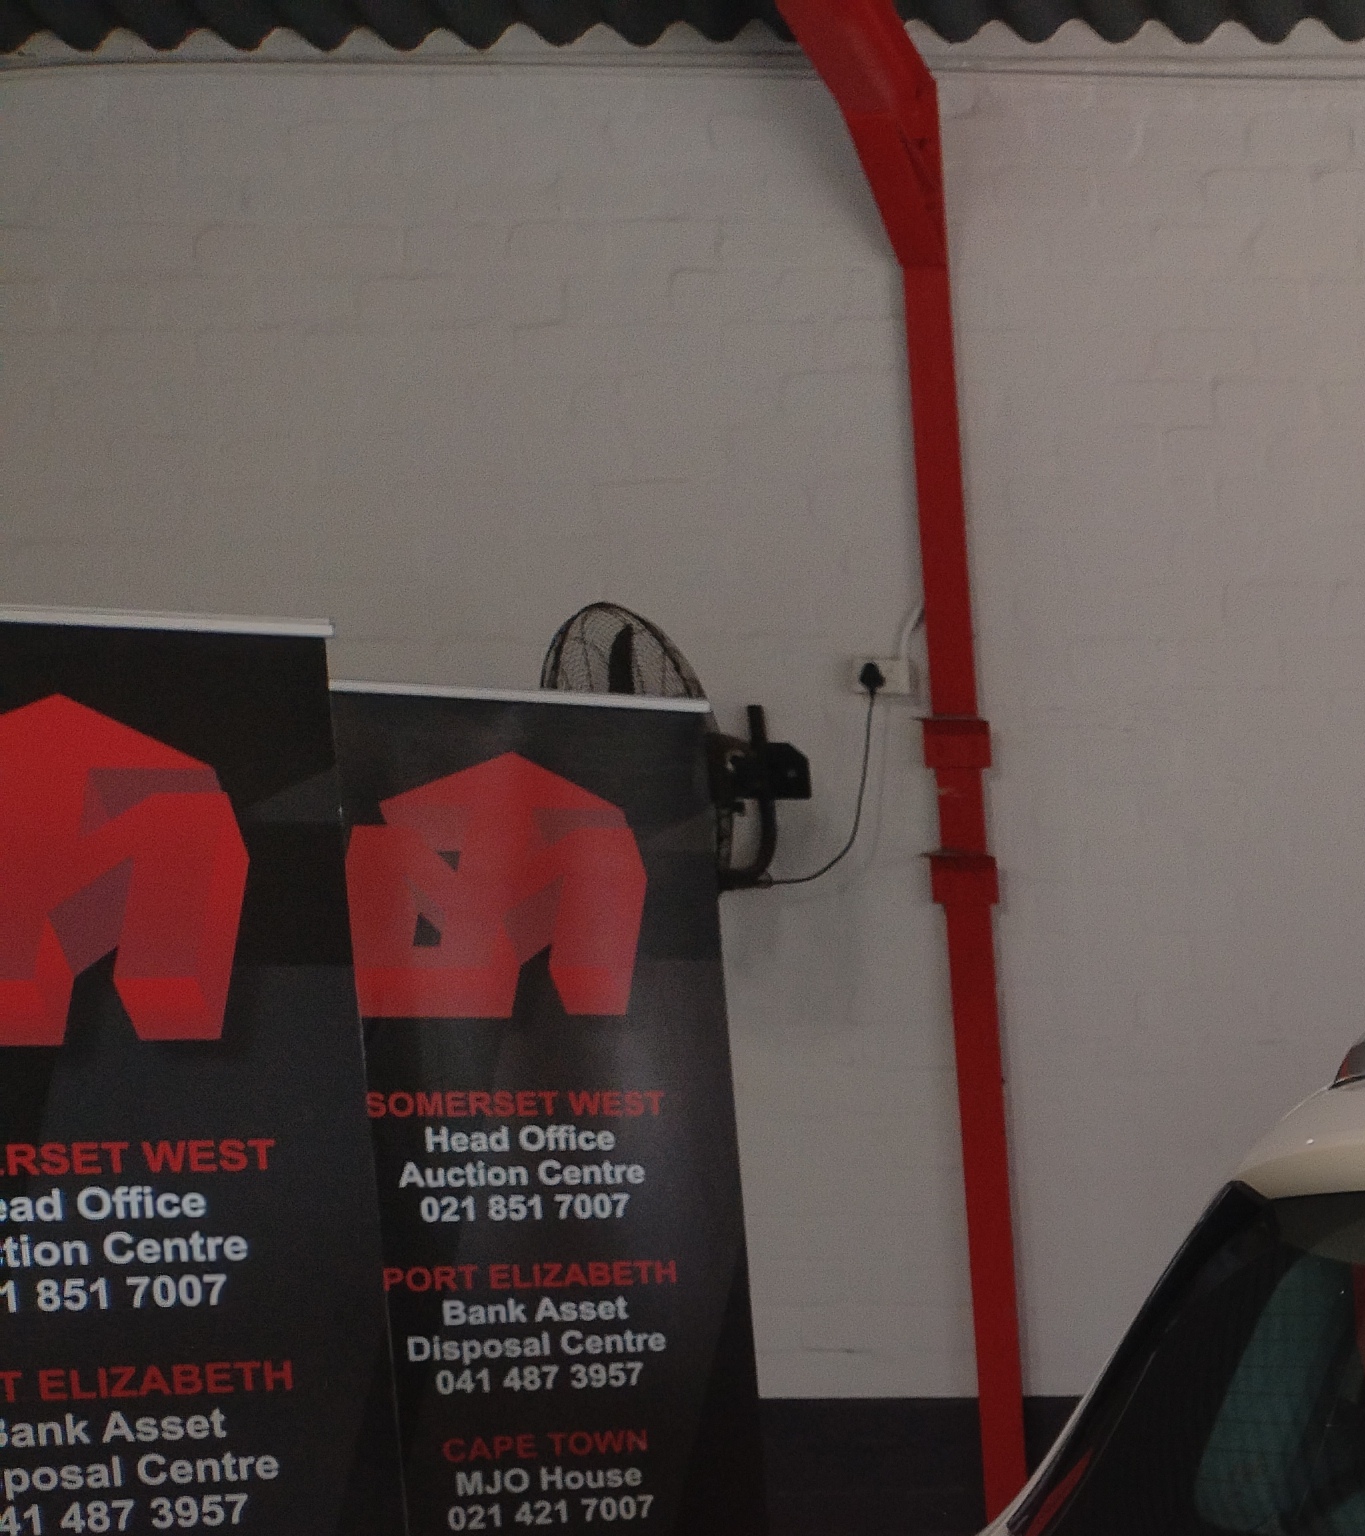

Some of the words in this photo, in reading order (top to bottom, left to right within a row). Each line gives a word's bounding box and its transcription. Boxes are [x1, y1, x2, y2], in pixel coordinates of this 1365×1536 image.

[366, 1090, 559, 1119] SOMERSET
[570, 1090, 667, 1117] WEST
[424, 1125, 510, 1154] Head
[519, 1124, 616, 1152] Office
[0, 1141, 129, 1176] RSET
[142, 1138, 276, 1174] WEST
[398, 1160, 529, 1189] Auction
[538, 1158, 646, 1186] Centre
[0, 1187, 63, 1222] ad
[77, 1186, 207, 1220] Office
[419, 1195, 476, 1223] 021
[487, 1194, 544, 1222] 851
[554, 1192, 631, 1220] 7007
[0, 1234, 89, 1268] tion
[103, 1230, 249, 1265] Centre
[37, 1277, 109, 1312] 851
[126, 1274, 228, 1309] 7007
[382, 1264, 478, 1293] PORT
[489, 1260, 678, 1289] ELIZABETH
[442, 1298, 526, 1327] Bank
[535, 1295, 630, 1323] Asset
[406, 1331, 551, 1366] Disposal
[560, 1329, 668, 1356] Centre
[38, 1360, 295, 1400] ELIZABETH
[435, 1368, 491, 1395] 041
[503, 1365, 560, 1392] 487
[570, 1362, 645, 1389] 3957
[102, 1409, 228, 1444] Asset
[442, 1433, 538, 1463] CAPE
[547, 1428, 649, 1457] TOWN
[138, 1451, 281, 1486] Centre
[455, 1467, 530, 1497] MJO
[540, 1466, 643, 1491] House
[60, 1499, 135, 1534] 487
[151, 1493, 249, 1529] 3957
[448, 1504, 503, 1531] 021
[514, 1500, 569, 1526] 421
[581, 1494, 655, 1523] 7007
